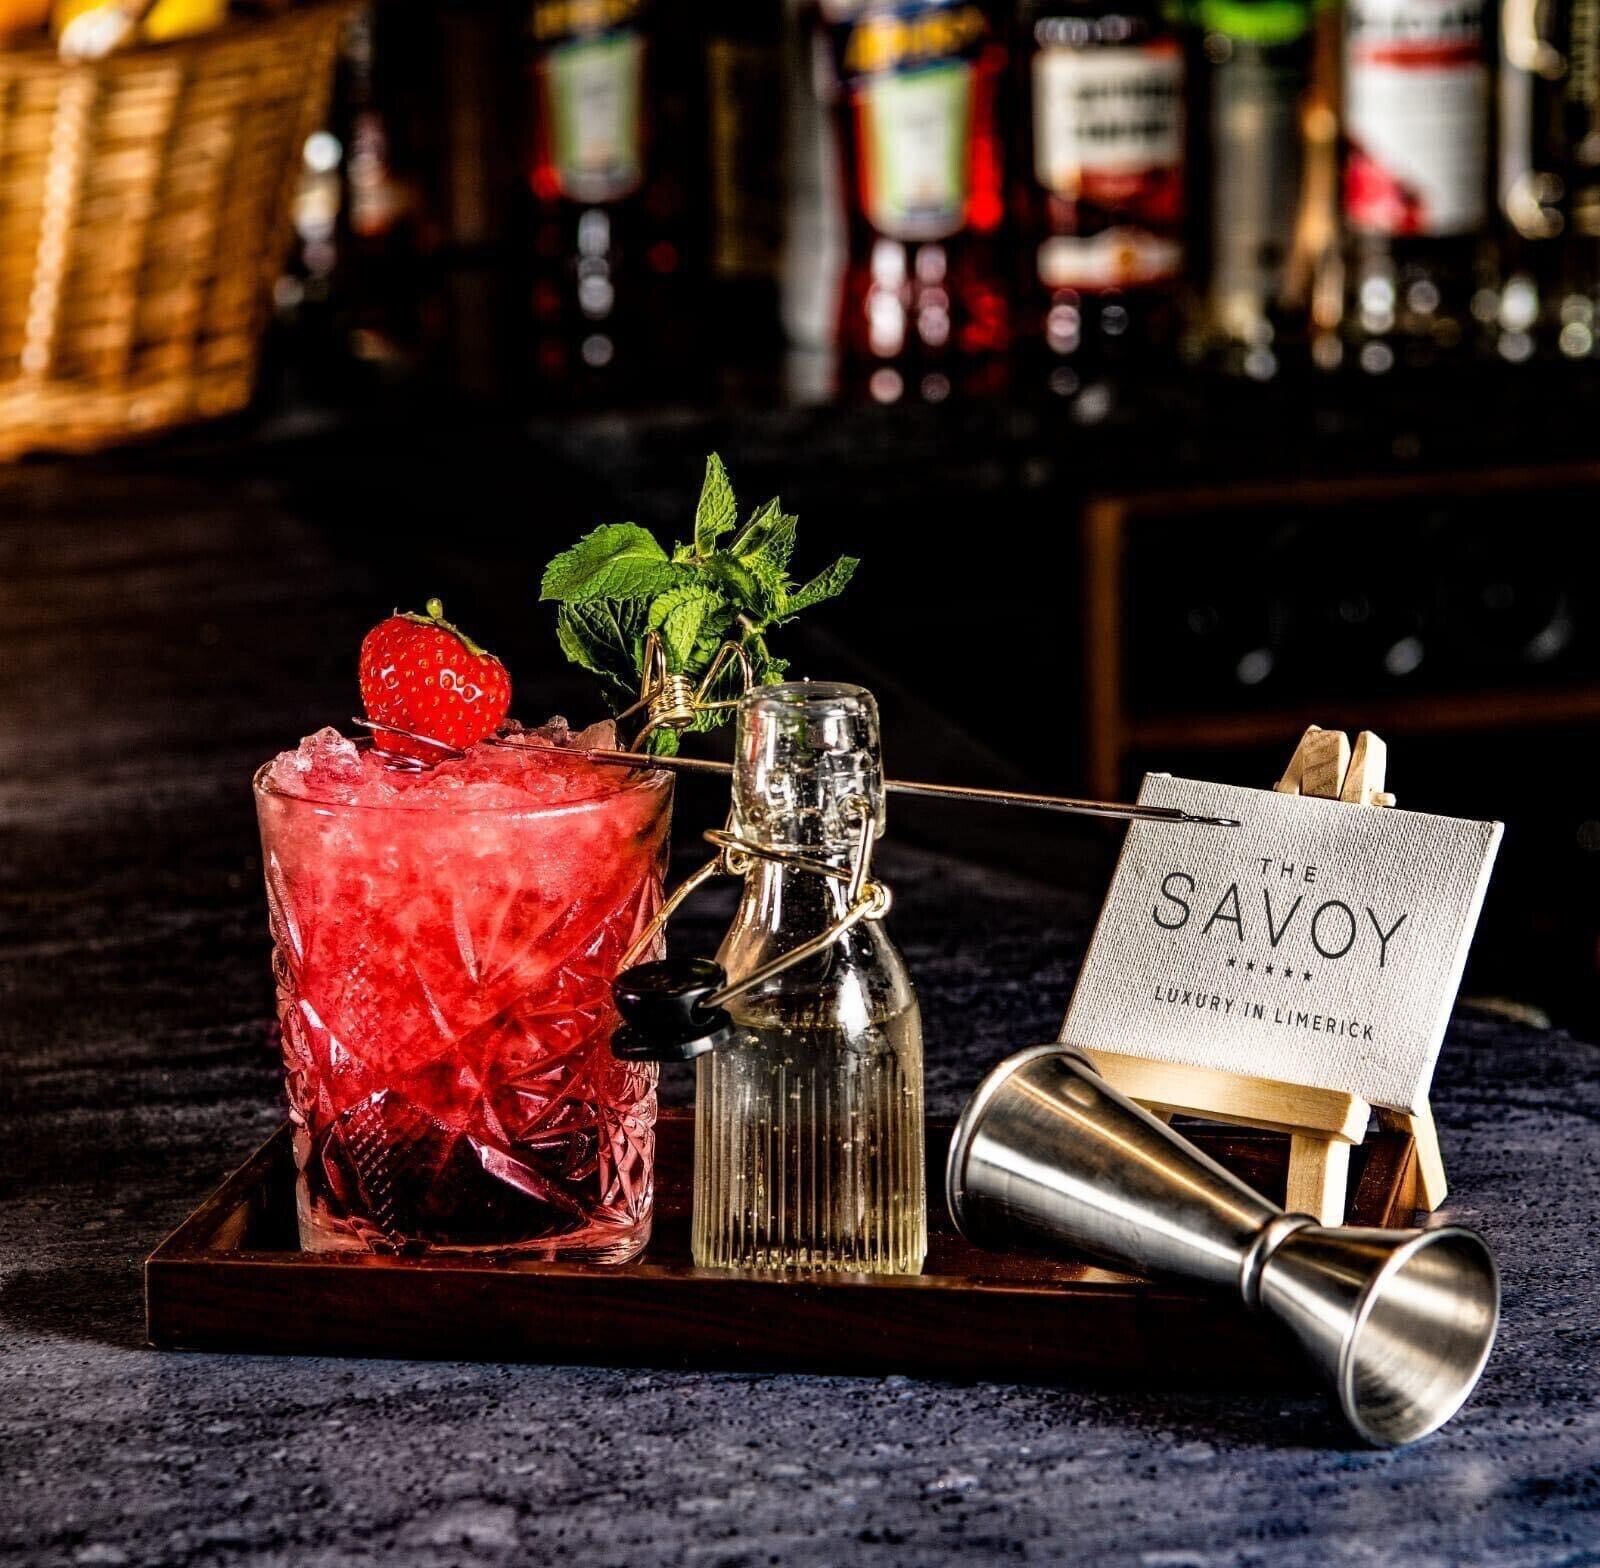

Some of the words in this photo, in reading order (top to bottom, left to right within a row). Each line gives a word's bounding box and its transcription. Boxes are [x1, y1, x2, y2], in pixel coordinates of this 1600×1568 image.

[1260, 857, 1319, 883] THE
[1152, 871, 1408, 968] SAVOY
[1154, 985, 1235, 1014] LUXURY
[1244, 1001, 1265, 1020] IN
[1275, 1007, 1374, 1041] LIMERICK
